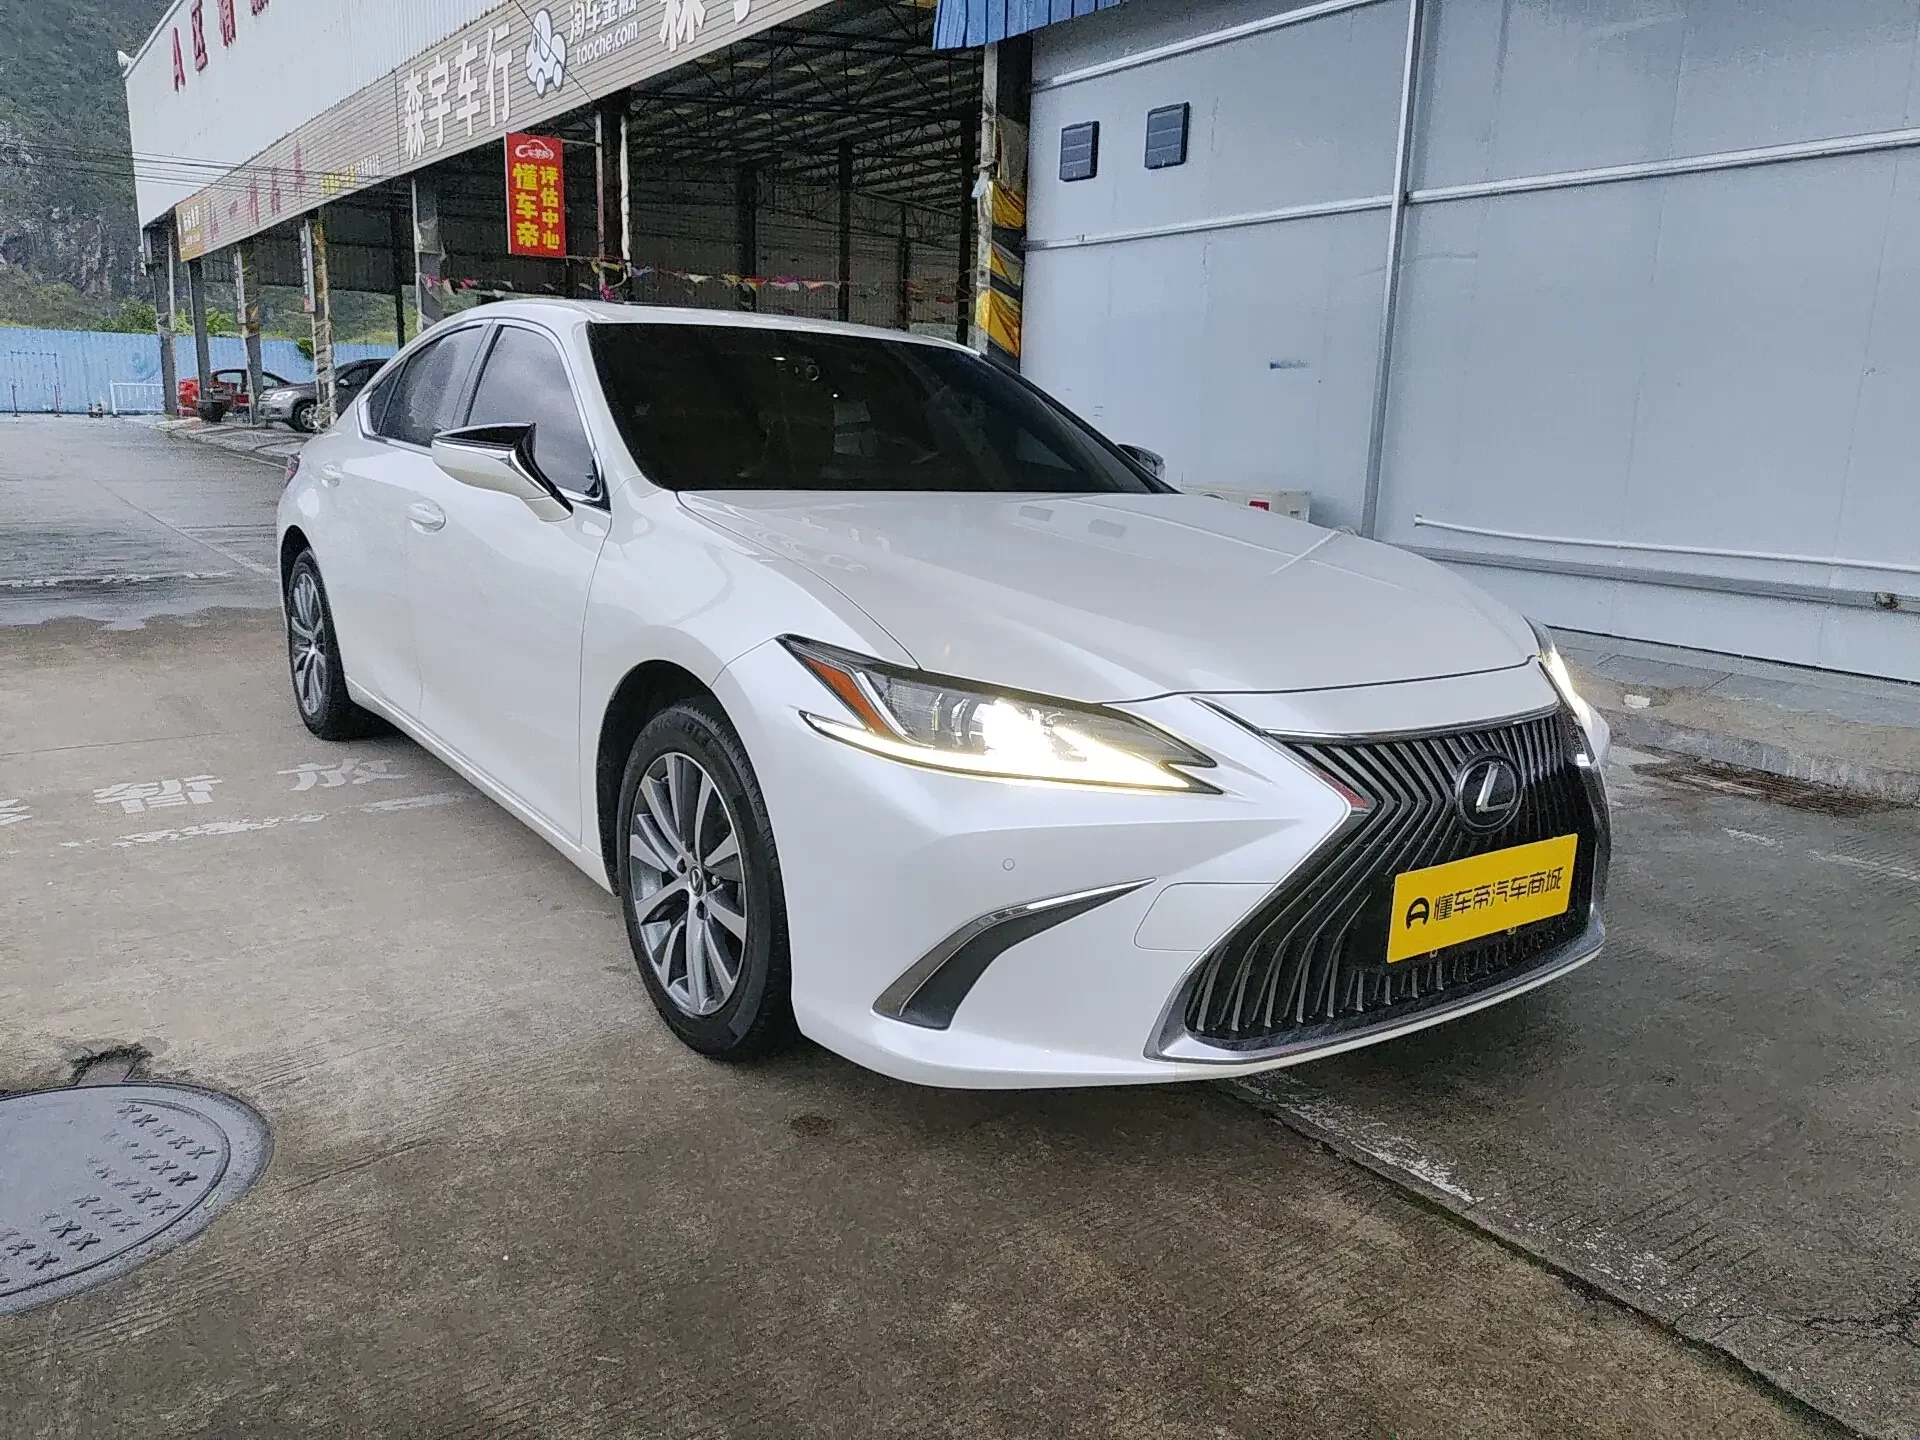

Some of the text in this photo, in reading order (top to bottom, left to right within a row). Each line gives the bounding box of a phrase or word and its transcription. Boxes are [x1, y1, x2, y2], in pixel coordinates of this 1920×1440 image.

[576, 21, 638, 65] taoche.com
[404, 22, 513, 161] 森宇车行
[512, 163, 539, 248] 懂车帝
[540, 166, 560, 250] 评估中心
[1433, 866, 1564, 922] 懂车帝汽车商城
